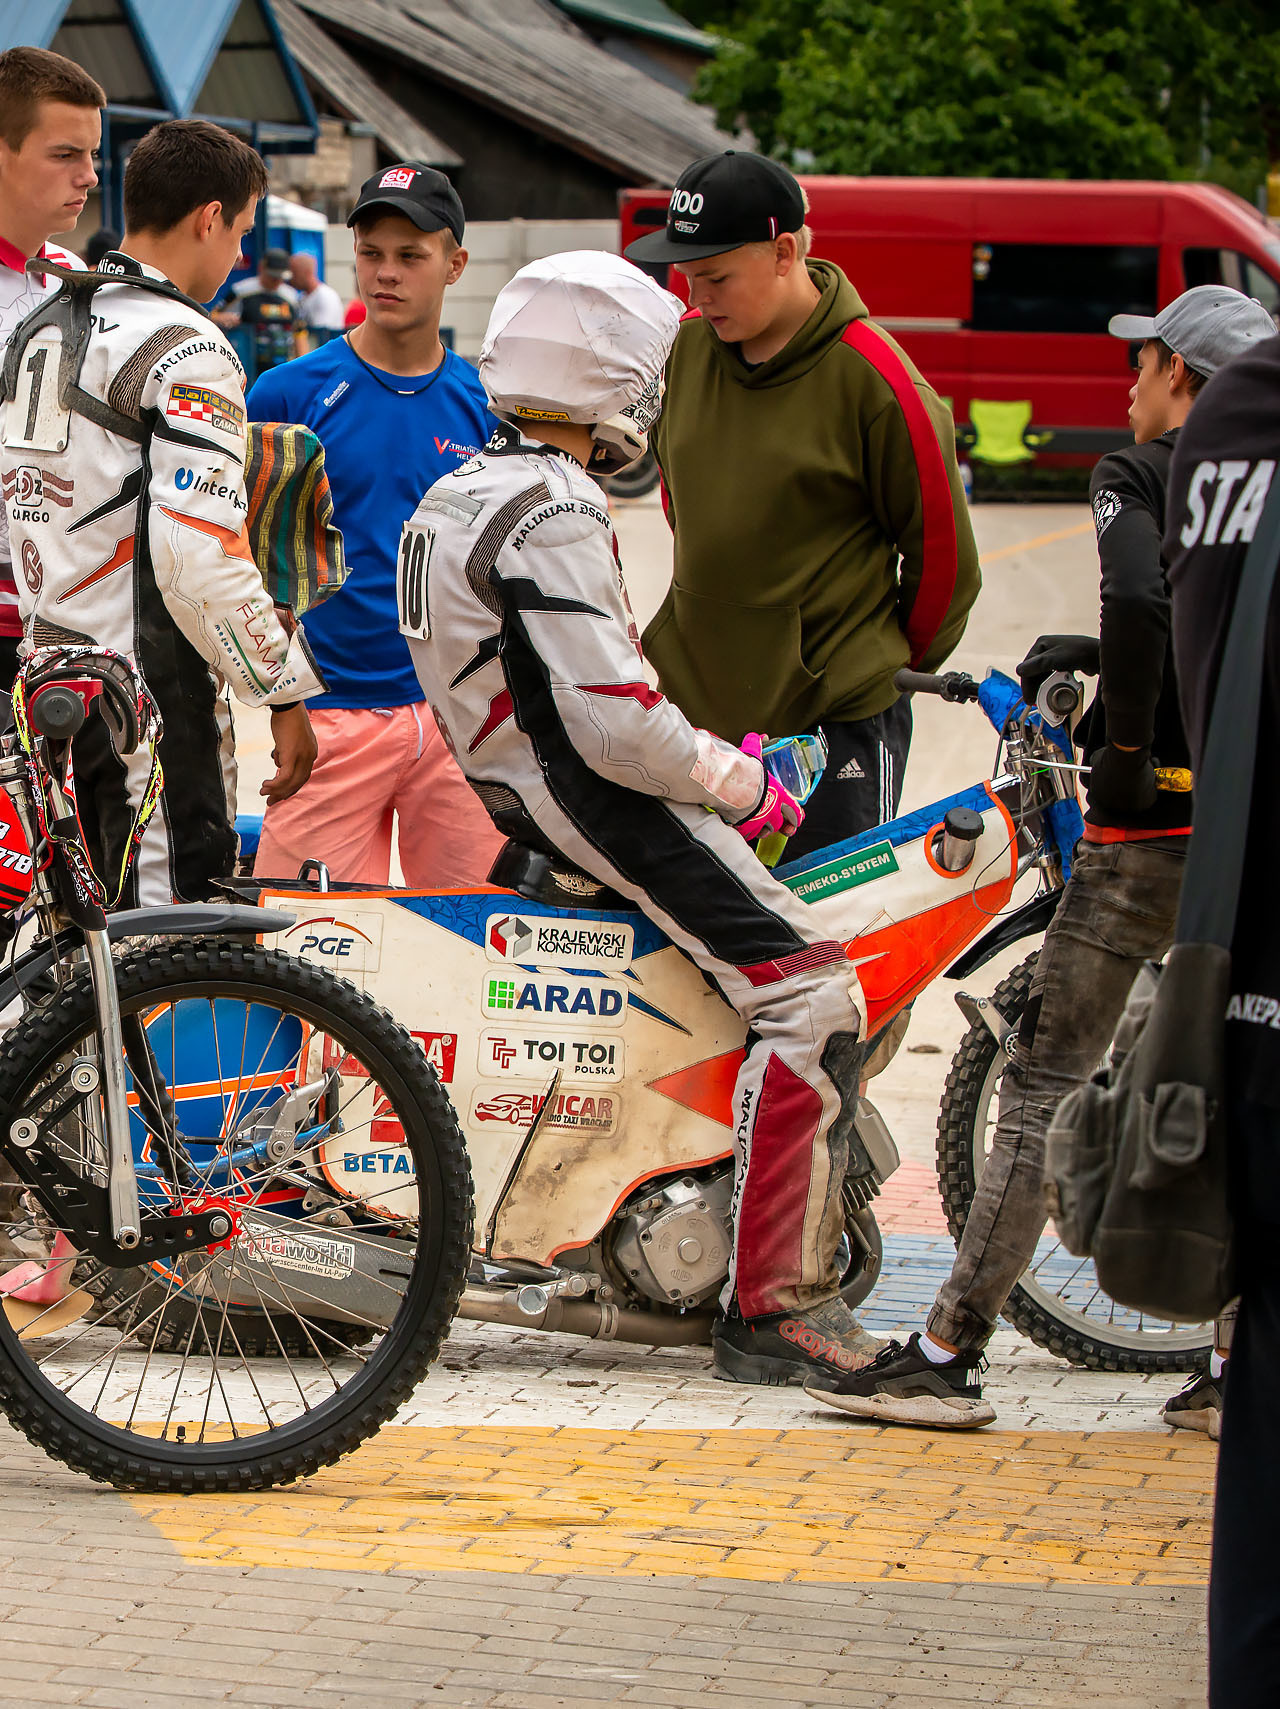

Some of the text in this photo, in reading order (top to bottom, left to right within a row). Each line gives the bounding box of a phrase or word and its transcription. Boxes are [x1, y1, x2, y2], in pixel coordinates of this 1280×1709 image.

[97, 259, 126, 276] Nice
[27, 349, 49, 441] 1
[12, 508, 50, 523] CARGO
[401, 530, 426, 631] 10
[836, 769, 866, 780] adidas
[299, 935, 355, 956] PGE
[538, 927, 626, 947] KRAJEWSKI
[536, 940, 625, 959] KONSTRUKCJE
[516, 982, 623, 1017] ARAD
[523, 1039, 616, 1065] TOI TOI
[574, 1065, 616, 1076] POLSKA
[563, 1115, 579, 1125] TAXI
